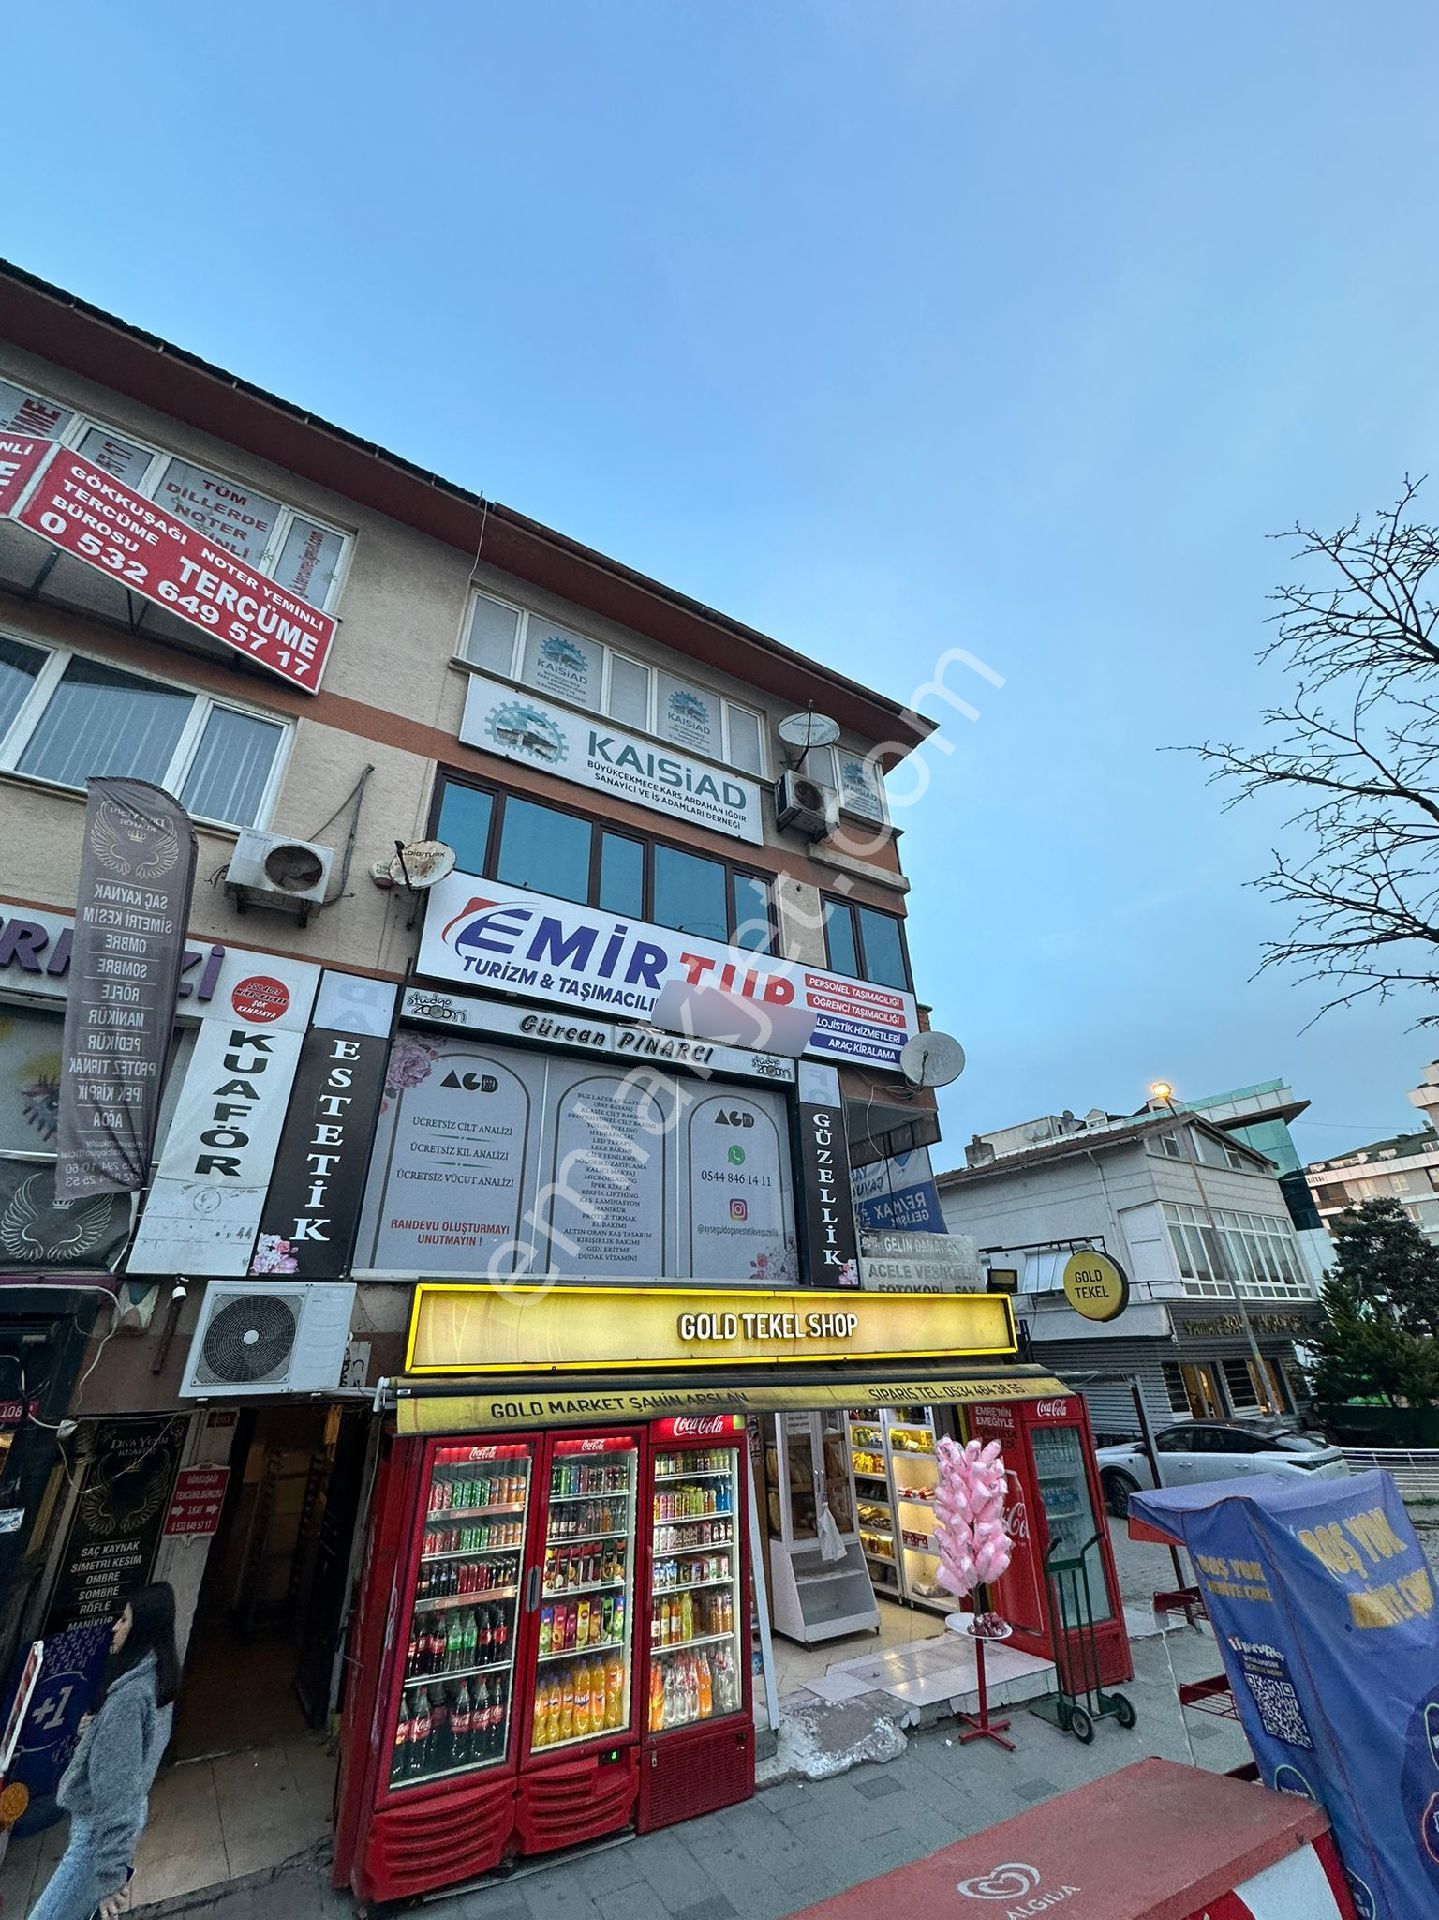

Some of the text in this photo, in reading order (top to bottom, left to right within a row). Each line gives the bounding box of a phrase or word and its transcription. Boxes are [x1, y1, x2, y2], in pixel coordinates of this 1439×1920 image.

[71, 466, 188, 545] GÖKKUŞAĞI
[202, 479, 247, 506] TÜM
[63, 480, 160, 546] TERCÜME
[166, 482, 268, 533] DİLLERDE
[174, 502, 248, 541] NOTER
[51, 495, 140, 552] BÜROSU
[40, 511, 311, 676] 0 532 649 57 17
[201, 547, 259, 590] NOTER
[262, 587, 324, 632] YEMİNLİ
[179, 556, 320, 660] TERCÜME
[587, 760, 661, 792] BÜYÜKÇEKMECE
[659, 786, 683, 800] KARS
[685, 795, 723, 815] ARDAHAN
[594, 772, 637, 794] SANAYİCİ
[638, 788, 650, 799] VE
[661, 798, 705, 818] ADAMLARI
[704, 812, 741, 830] DERNEĞİ
[455, 908, 669, 990] EMİR
[463, 956, 659, 1012] TURİZM & TAŞIMACILI
[809, 977, 851, 996] PERSONEL
[812, 996, 850, 1013] ÖĞRENCİ
[519, 1014, 714, 1065] Gürcan PINARCI
[816, 1016, 901, 1044] LOJİSTİK HİZMETLERİ
[828, 1037, 897, 1061] ARAÇ KİRALAMA
[194, 1029, 275, 1178] KUAFÖR
[289, 1038, 361, 1242] ESTETİK
[445, 1174, 478, 1185] VÜCUT
[701, 1170, 772, 1187] 0544 846 14 11
[812, 1113, 844, 1266] GÜZELLİK
[391, 1219, 511, 1236] RANDEVU OLUŞTURMAYI
[417, 1234, 477, 1247] UNUTMAYIN
[869, 1263, 913, 1279] ACELE
[1075, 1269, 1103, 1283] GOLD
[1075, 1285, 1109, 1299] TEKEL
[680, 1312, 859, 1341] GOLD TEKEL SHOP
[490, 1392, 750, 1419] GOLD MARKET ŞAHİN ARSLAN
[915, 1386, 945, 1400] TEL:
[1, 1405, 23, 1418] 108
[81, 1540, 141, 1558] SAÇ KAYNAK
[85, 1571, 120, 1585] OMBRE
[79, 1585, 120, 1601] SOMBRE
[80, 1600, 112, 1614] RÖFLE
[32, 1685, 75, 1731] +1
